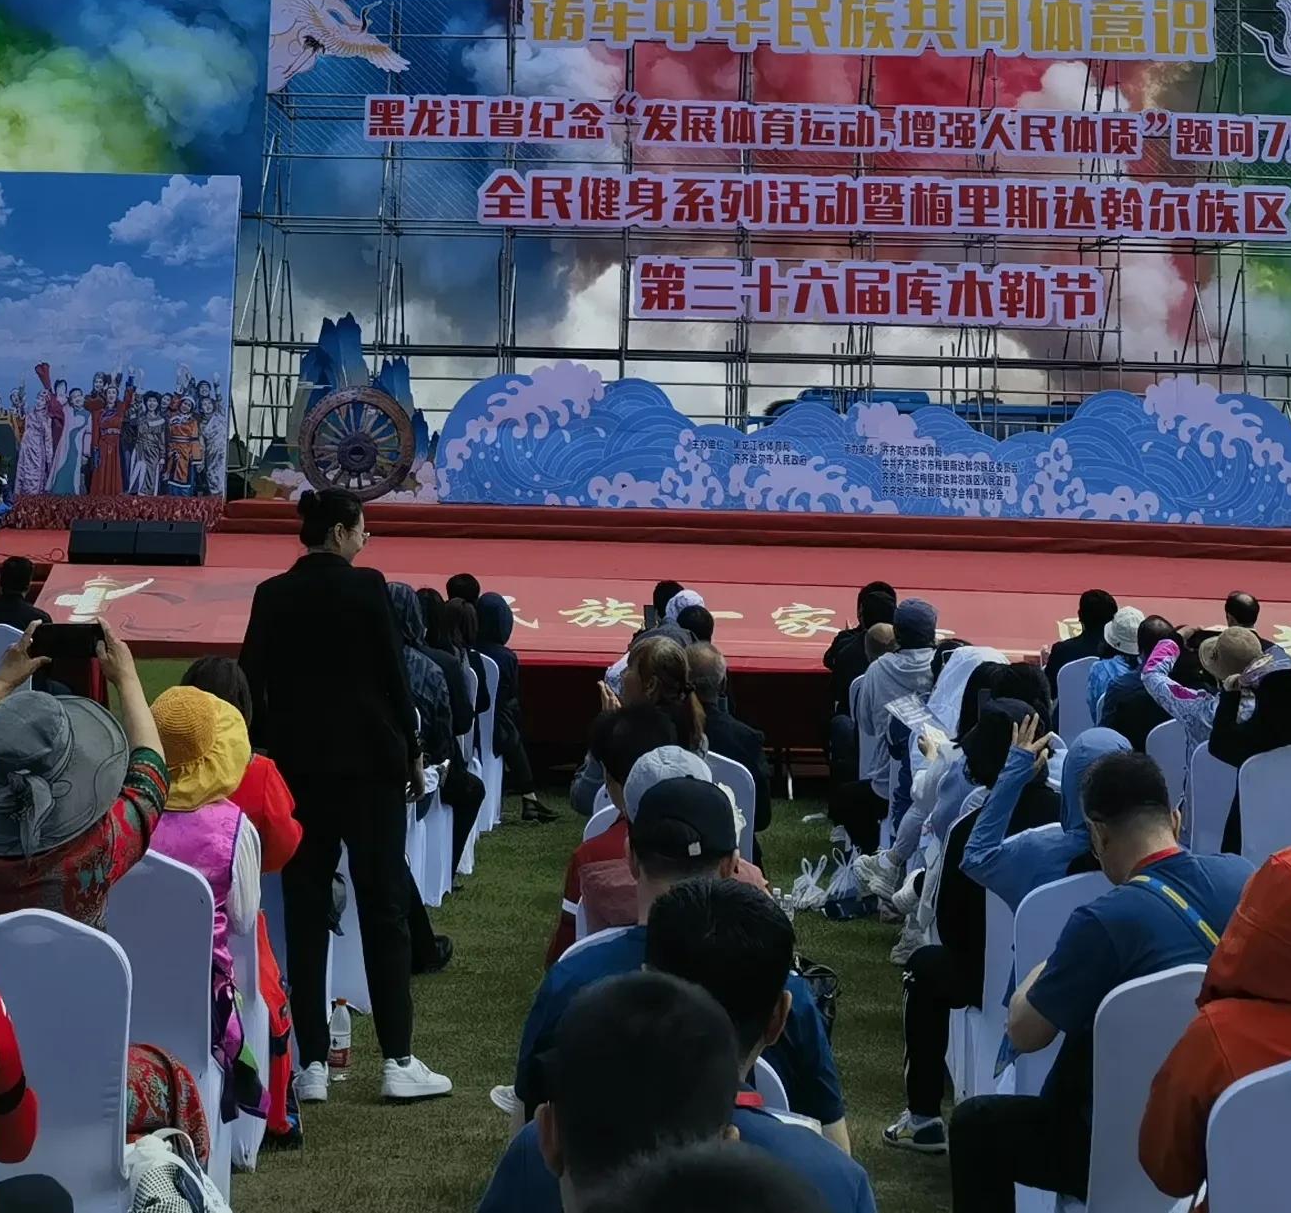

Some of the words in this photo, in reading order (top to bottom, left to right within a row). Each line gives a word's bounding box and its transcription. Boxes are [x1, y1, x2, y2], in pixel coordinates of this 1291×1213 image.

[483, 174, 1288, 235] 全民健身系列活动暨梅里斯达斡尔族区
[640, 263, 1098, 320] 第三十六届库木勒节
